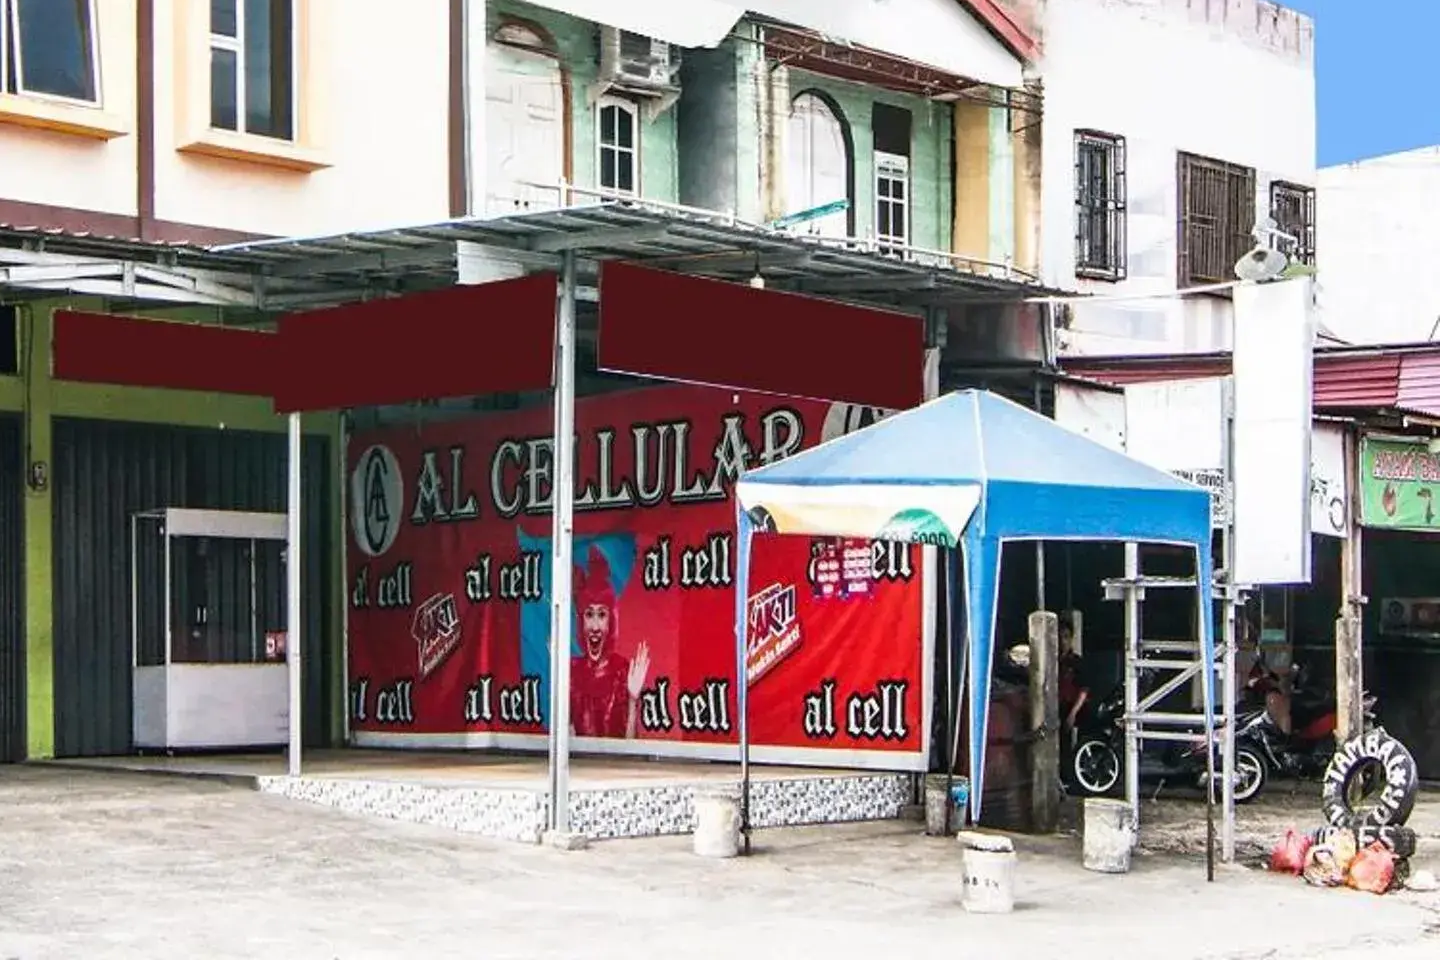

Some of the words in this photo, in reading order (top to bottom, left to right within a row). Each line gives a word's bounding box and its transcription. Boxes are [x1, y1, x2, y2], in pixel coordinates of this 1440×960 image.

[411, 449, 480, 524] AL
[491, 406, 804, 520] CELLULAR
[377, 560, 413, 609] cell
[464, 551, 492, 602] al
[499, 551, 542, 602] cell
[643, 536, 672, 588] al
[680, 533, 733, 587] cell
[374, 678, 415, 725] cell
[463, 675, 494, 723] al
[500, 675, 544, 724] cell
[642, 680, 673, 730] al
[678, 680, 732, 732] cell
[804, 681, 837, 736] al
[846, 680, 909, 740] cell
